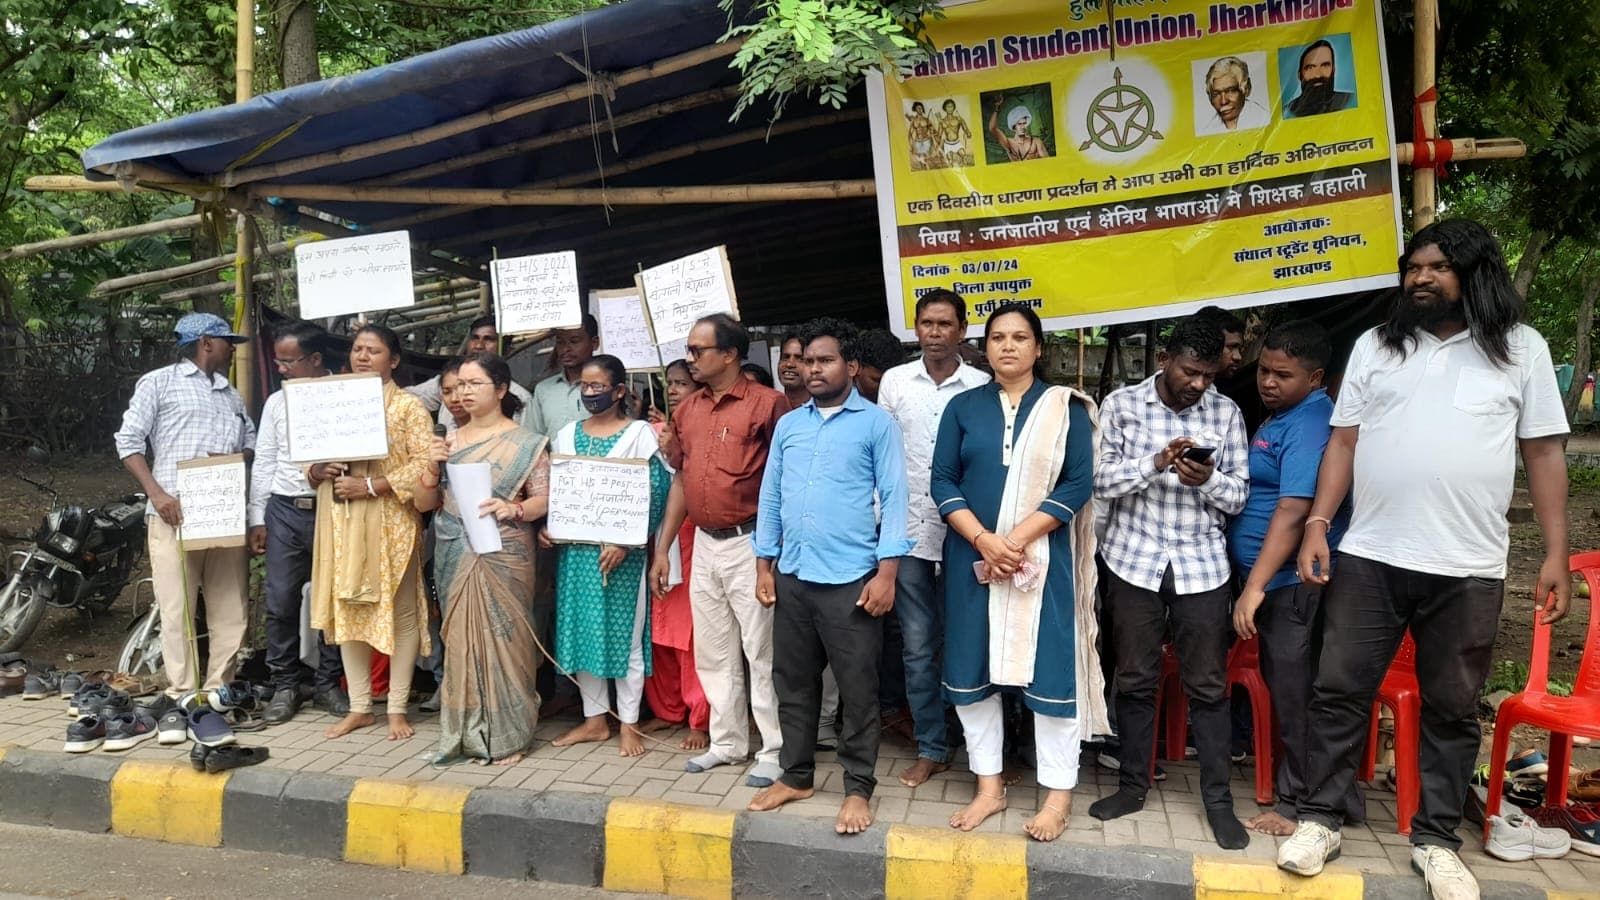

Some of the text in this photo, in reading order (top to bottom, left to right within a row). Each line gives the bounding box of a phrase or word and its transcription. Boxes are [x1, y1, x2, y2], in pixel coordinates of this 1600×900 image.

[903, 39, 998, 79] anthal
[1002, 25, 1110, 64] Student
[1115, 11, 1203, 47] Union,
[907, 199, 933, 214] एक
[938, 191, 993, 211] दिवसीय
[998, 189, 1042, 205] धारणा
[1047, 177, 1098, 201] प्रदर्शन
[1122, 173, 1154, 190] आप
[1160, 164, 1195, 184] सभी
[1200, 162, 1222, 177] का
[1228, 150, 1280, 176] हार्दिक
[1286, 137, 1375, 164] अभिनन्दन
[919, 226, 961, 249] विषय
[979, 215, 1059, 243] जनजातीय
[1065, 212, 1092, 237] एवं
[1155, 191, 1220, 222] भाषाओं
[1248, 180, 1304, 209] शिक्षक
[1311, 168, 1367, 198] बहाली
[1233, 246, 1272, 262] संथाल
[912, 264, 950, 277] दिनांक
[962, 259, 1018, 275] 03/07/24
[1273, 260, 1332, 279] झारखण्ड
[953, 282, 985, 295] जिला
